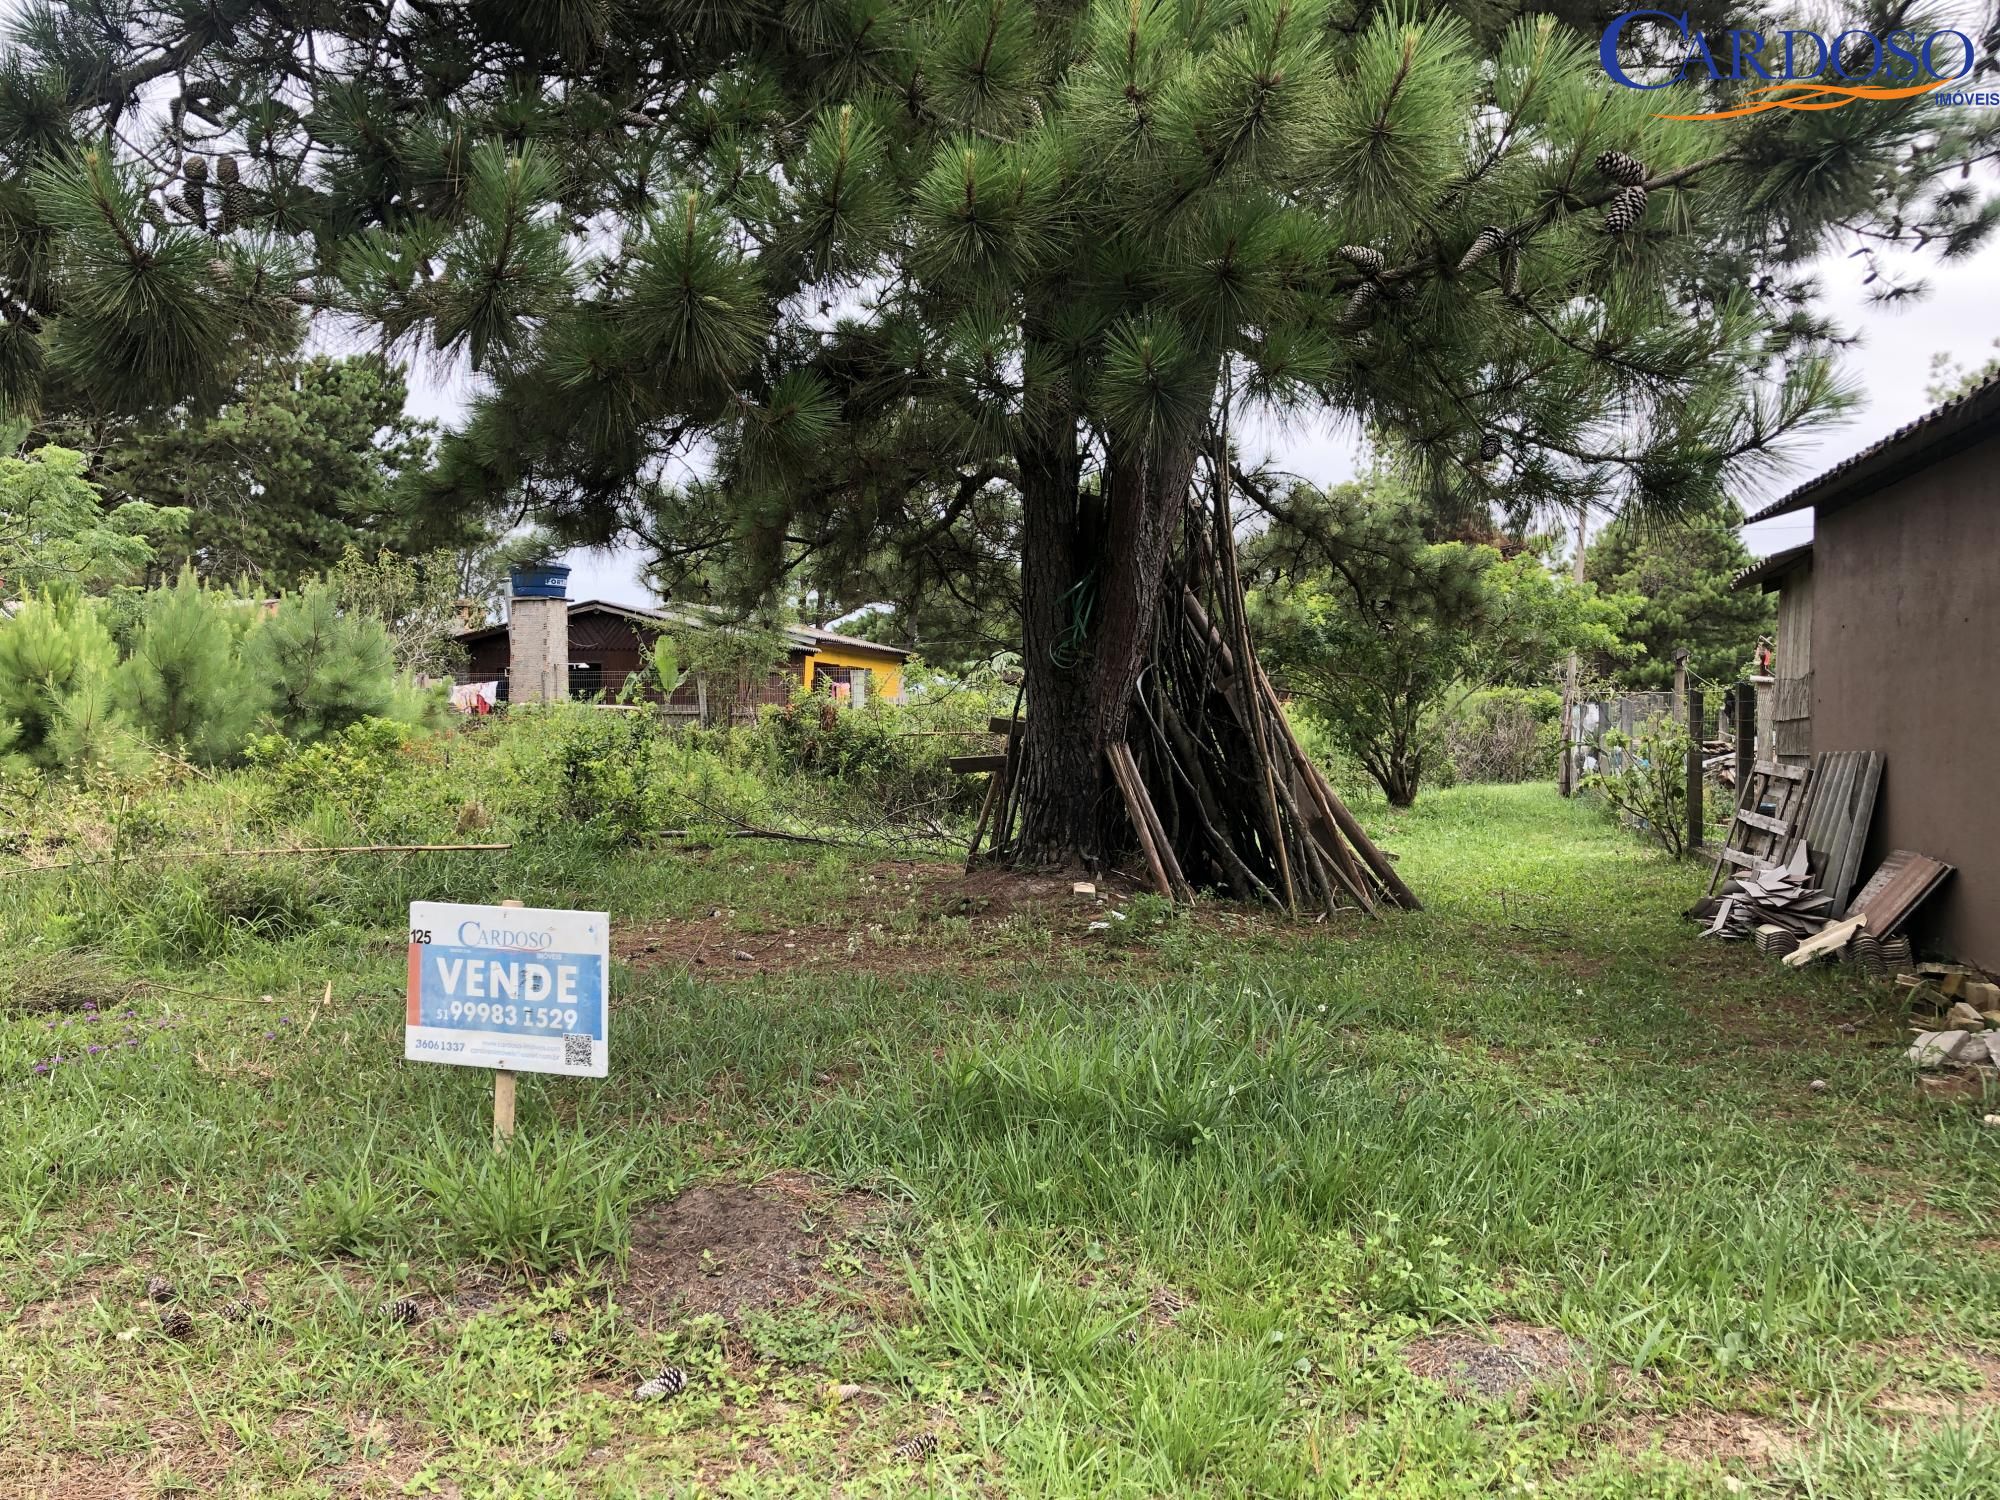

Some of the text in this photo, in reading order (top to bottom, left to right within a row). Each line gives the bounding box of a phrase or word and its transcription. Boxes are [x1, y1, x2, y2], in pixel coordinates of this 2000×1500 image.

[410, 929, 432, 945] 125
[458, 921, 552, 948] CARDOSO
[436, 957, 578, 1004] VENDE
[450, 1001, 517, 1026] 99983
[523, 1006, 578, 1031] 1529
